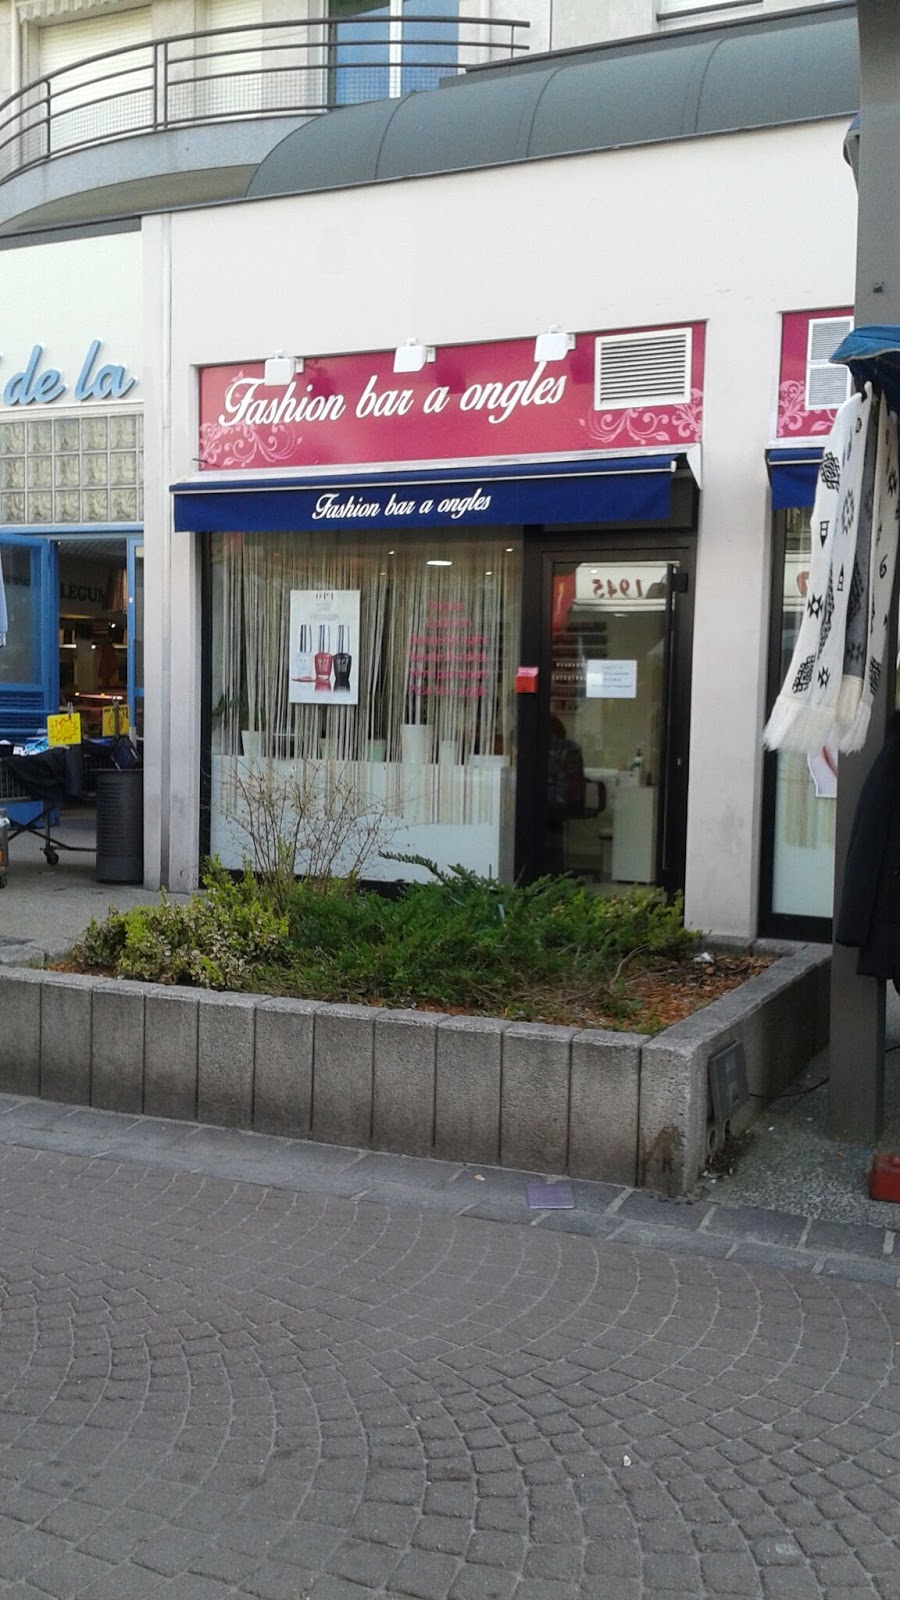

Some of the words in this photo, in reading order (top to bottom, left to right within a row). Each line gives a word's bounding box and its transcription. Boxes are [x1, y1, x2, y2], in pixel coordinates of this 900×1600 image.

[3, 344, 66, 405] de
[75, 339, 136, 401] la
[218, 377, 346, 427] Fashion
[355, 374, 414, 418] bar
[422, 385, 450, 414] a
[459, 360, 568, 424] ongles
[311, 492, 381, 520] Fashion
[384, 493, 416, 516] bar
[418, 499, 434, 514] a
[437, 487, 492, 520] ongles
